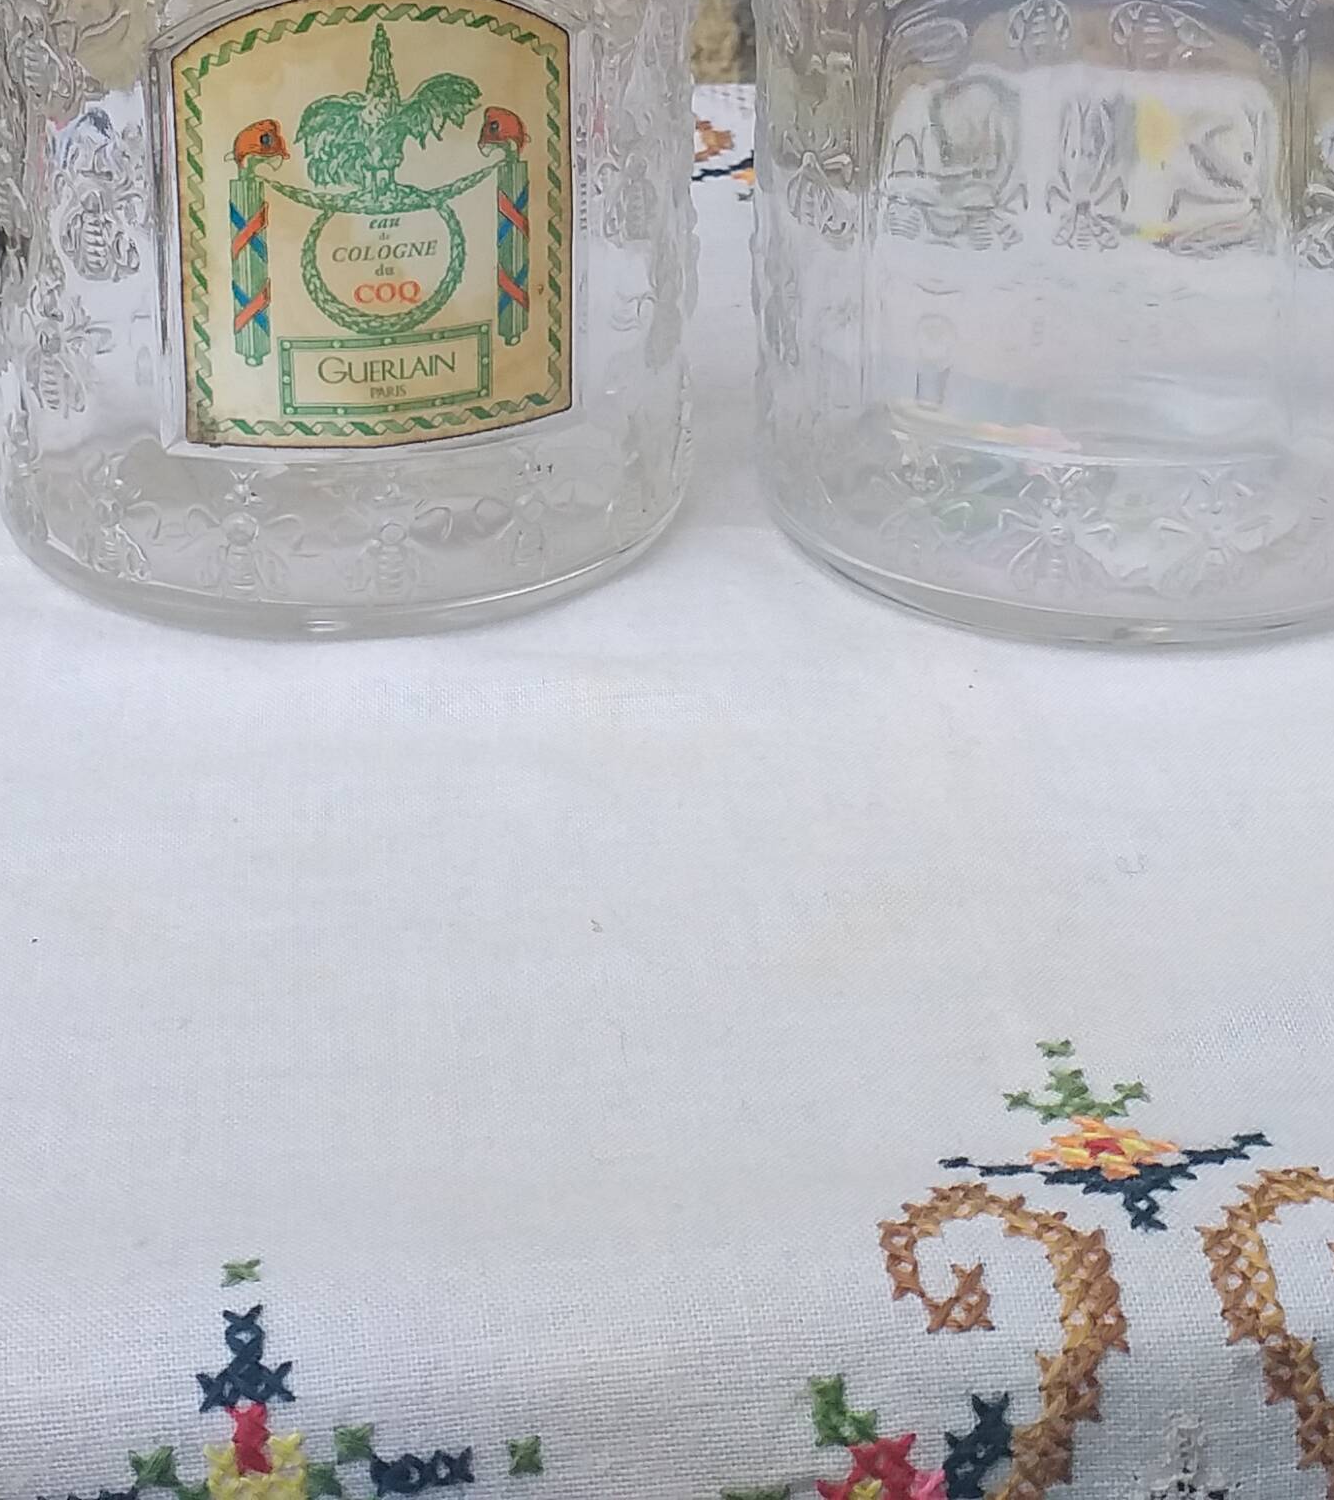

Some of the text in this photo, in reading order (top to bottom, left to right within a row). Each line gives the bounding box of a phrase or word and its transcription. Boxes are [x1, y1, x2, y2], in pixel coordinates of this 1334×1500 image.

[369, 217, 401, 229] eau
[332, 240, 438, 262] COLOGNE
[375, 263, 395, 276] du
[354, 281, 421, 304] COQ
[318, 352, 455, 384] GUERLAIN
[370, 385, 407, 398] PARIS
